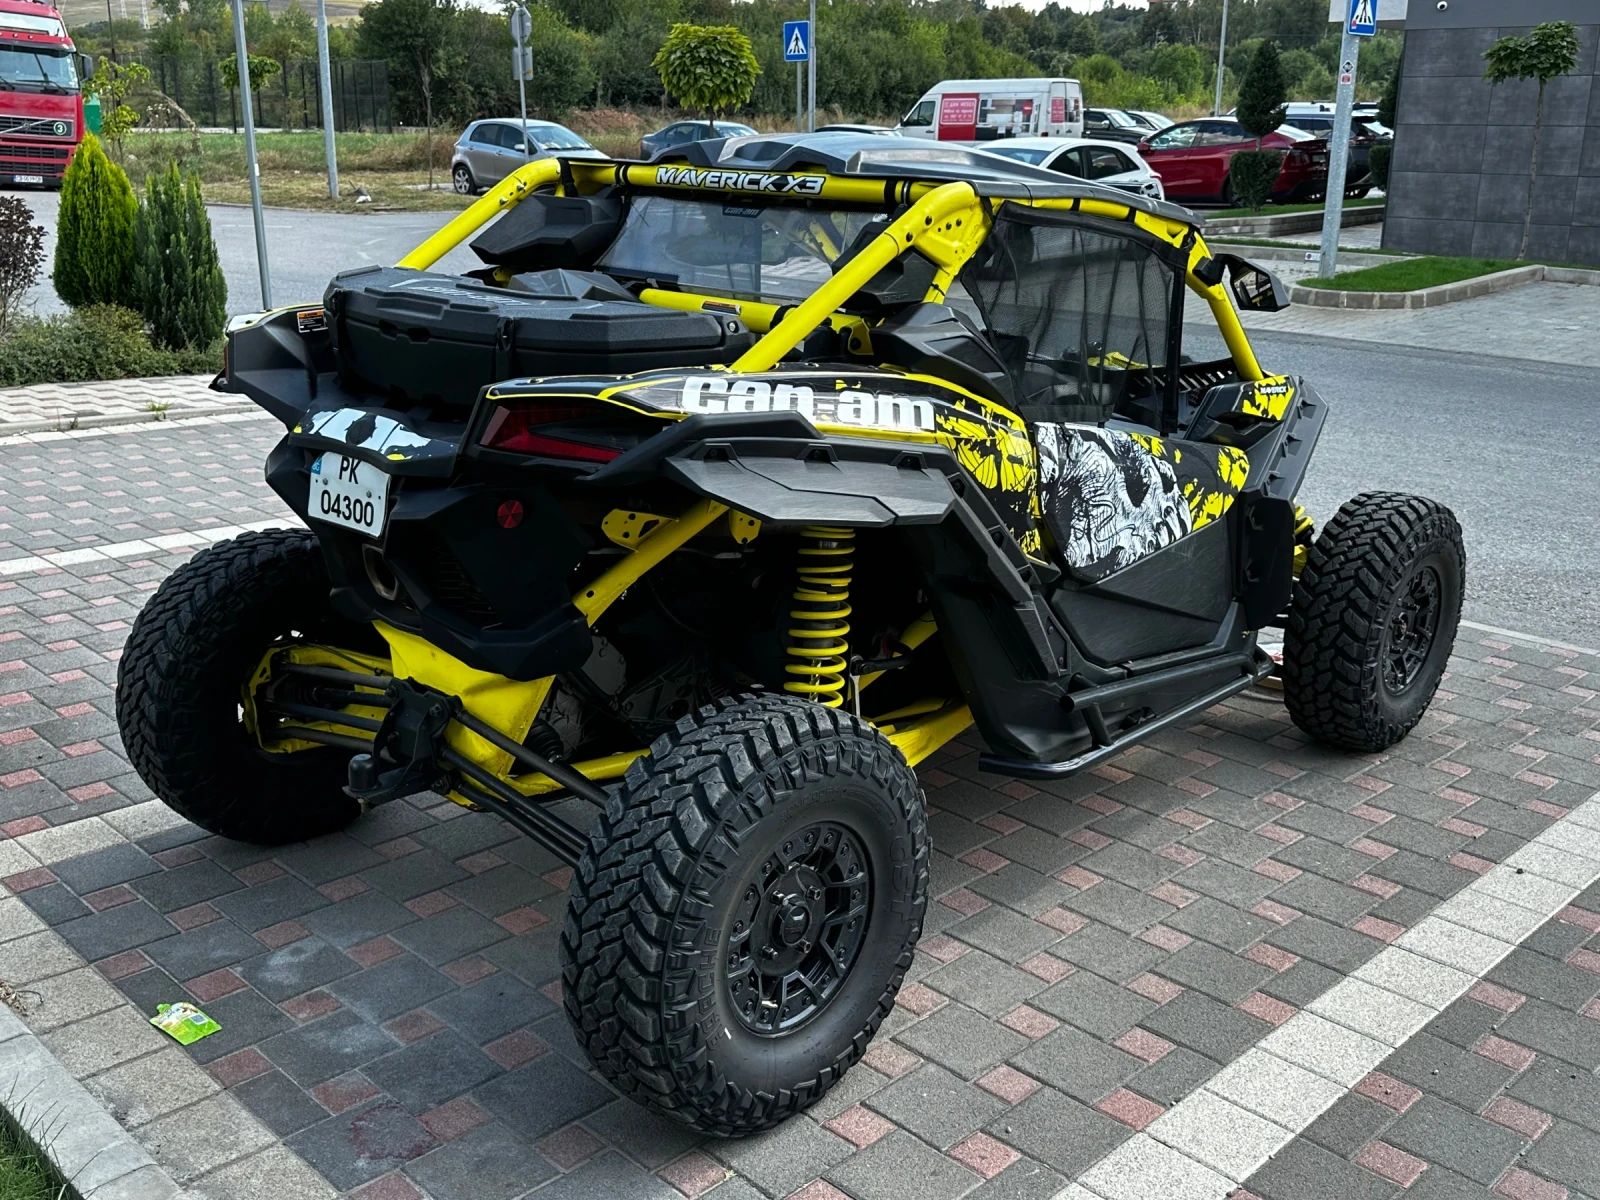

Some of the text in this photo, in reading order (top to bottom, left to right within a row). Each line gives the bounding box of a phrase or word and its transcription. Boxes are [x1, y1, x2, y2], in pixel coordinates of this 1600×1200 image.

[656, 167, 825, 195] MAVERICK X3
[1260, 386, 1287, 394] MAVERICK
[339, 456, 362, 485] PK
[321, 489, 374, 527] 04300
[697, 927, 725, 1051] APACHE
